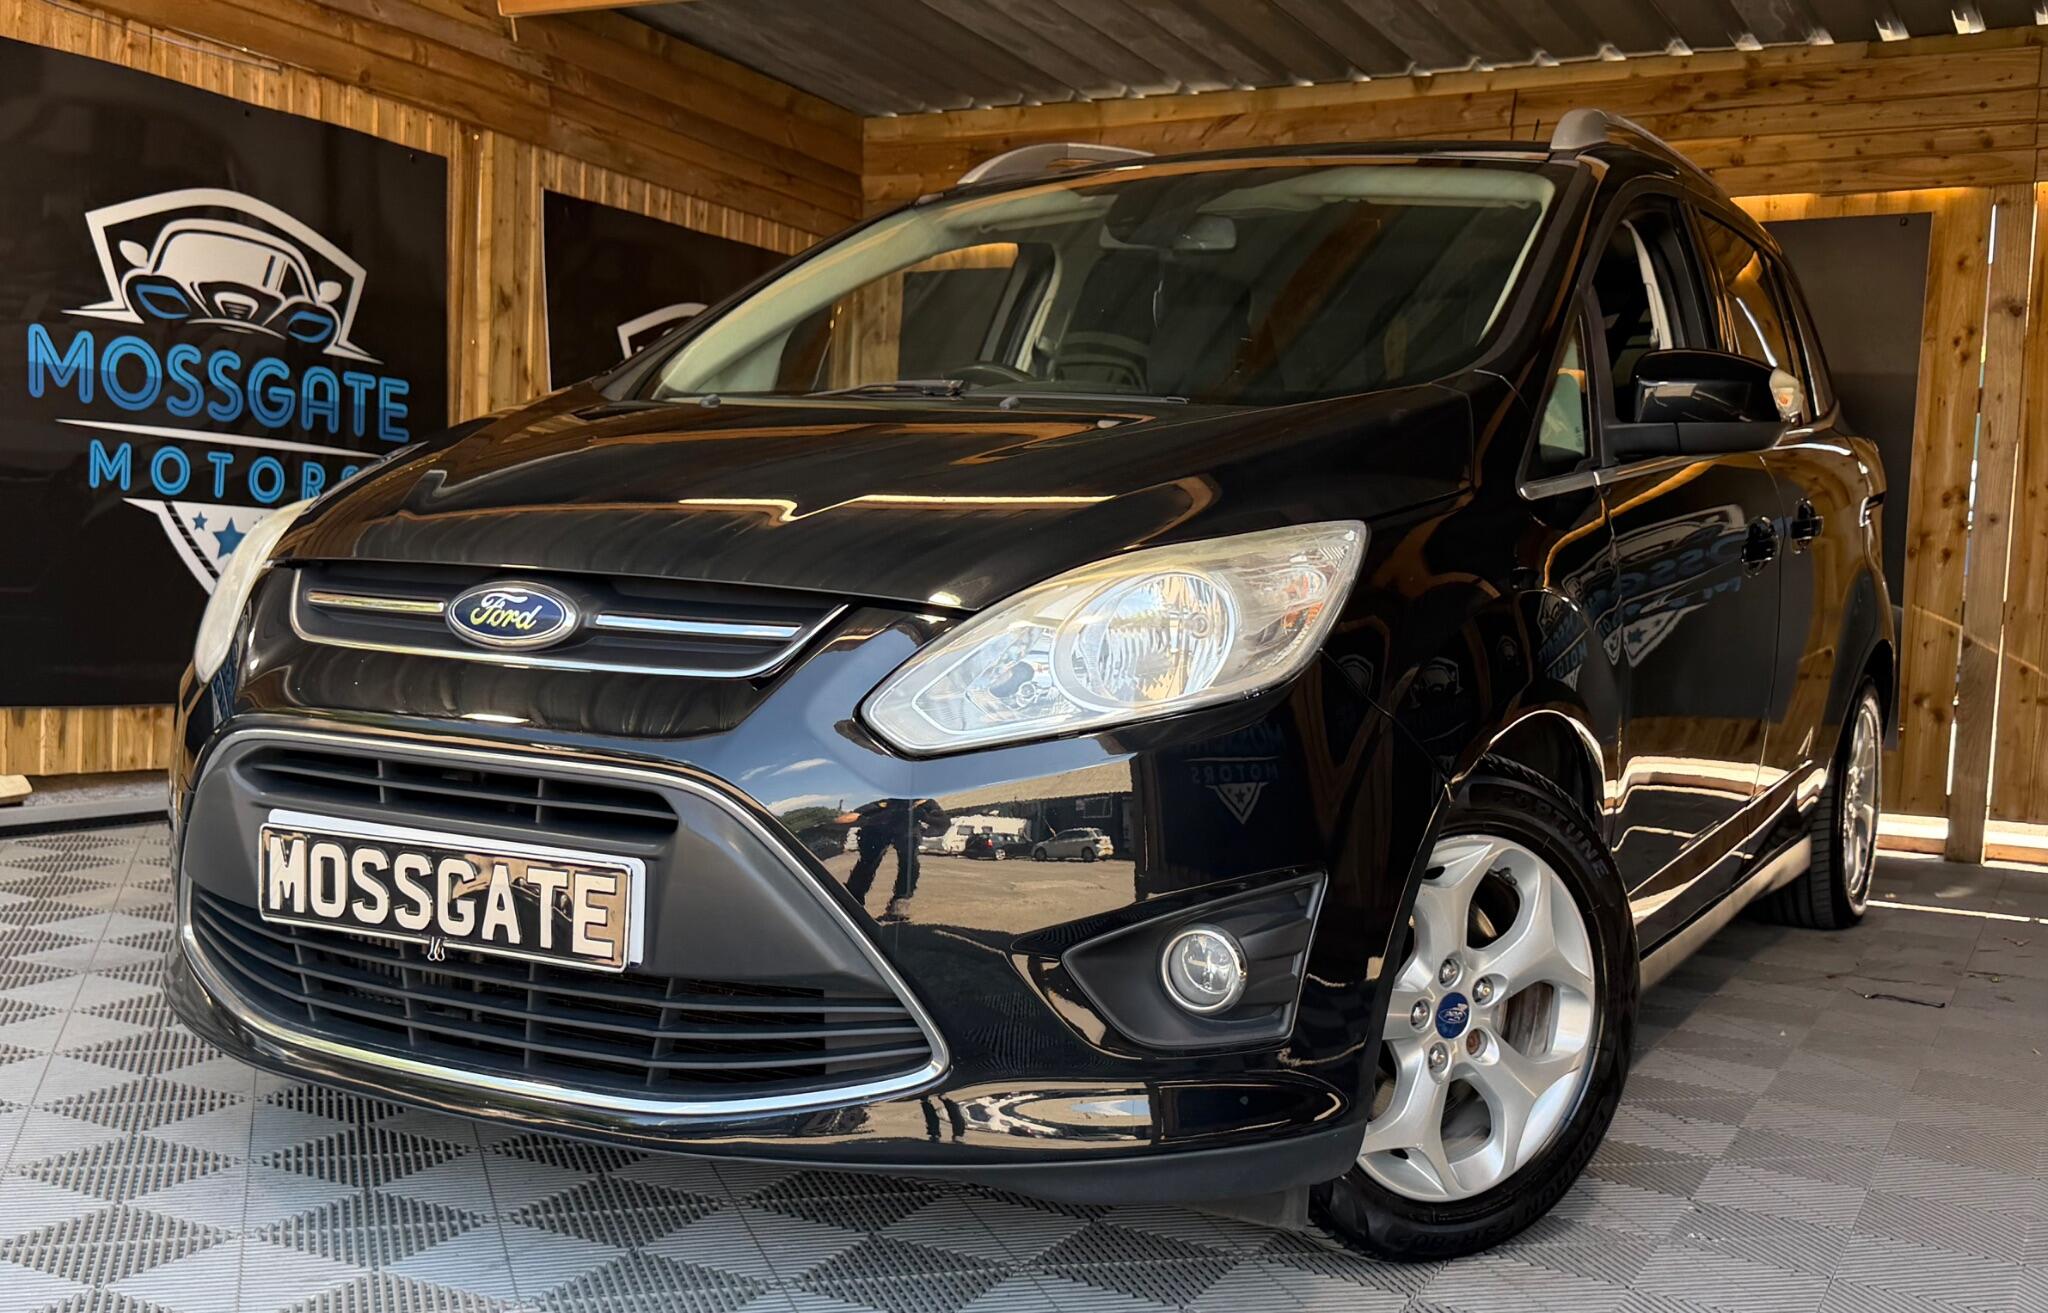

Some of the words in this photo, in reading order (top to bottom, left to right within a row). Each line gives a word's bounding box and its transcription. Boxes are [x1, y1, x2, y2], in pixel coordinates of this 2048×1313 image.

[28, 323, 409, 443] MOSSGATE
[470, 591, 543, 631] Ford
[1495, 788, 1610, 879] FORTUNE
[268, 836, 617, 959] MOSSGATE
